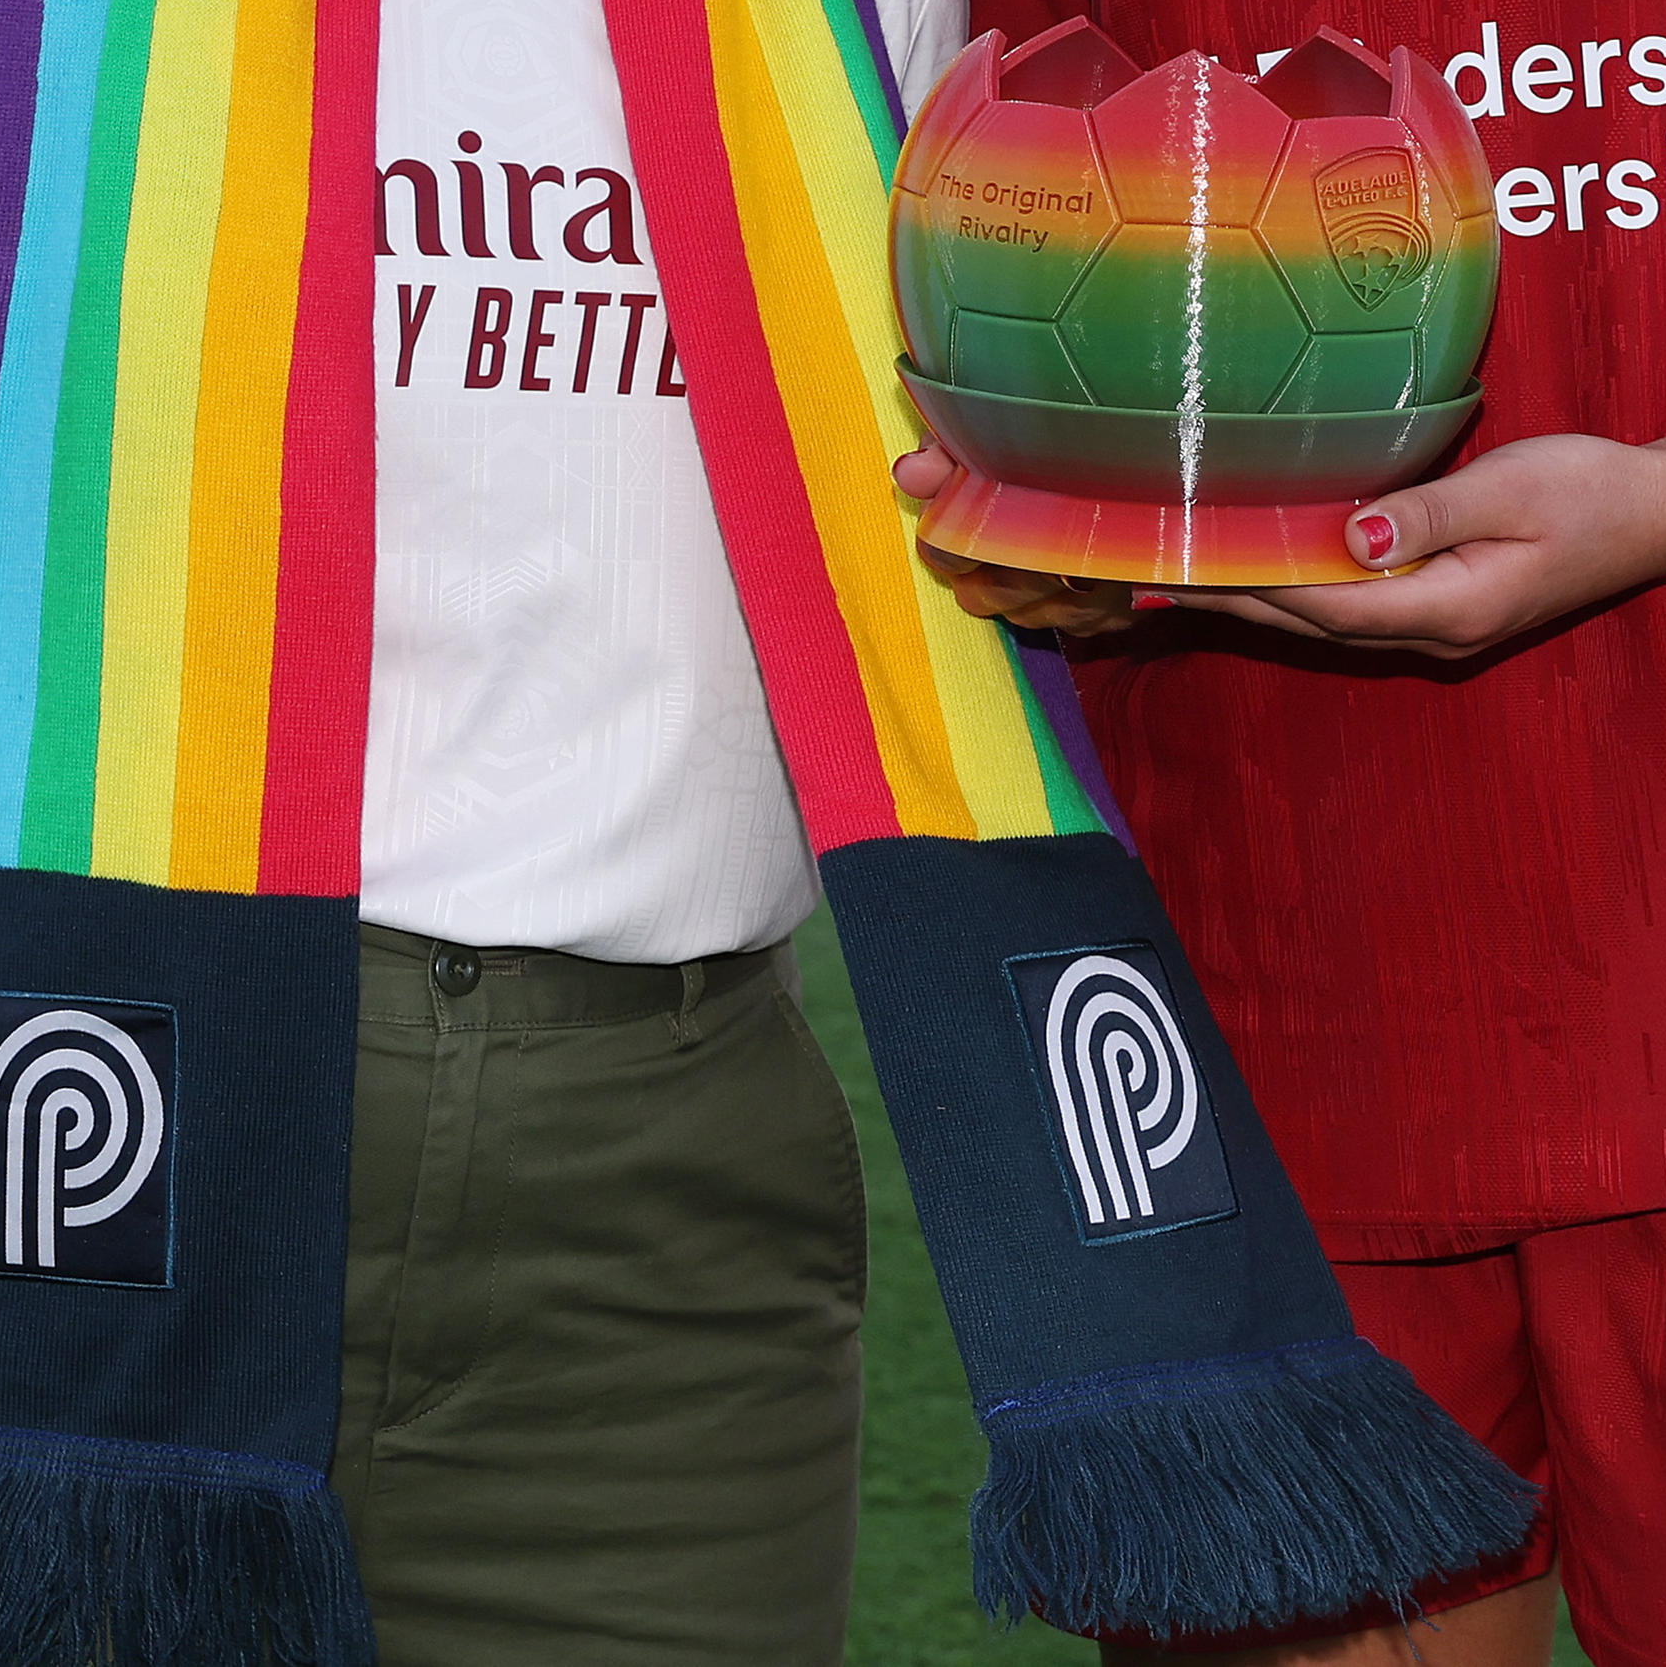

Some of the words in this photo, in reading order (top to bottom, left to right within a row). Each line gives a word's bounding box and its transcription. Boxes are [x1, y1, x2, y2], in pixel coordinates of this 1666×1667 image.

[940, 174, 975, 201] The
[982, 182, 1093, 215] Original
[1323, 171, 1409, 195] ADELAIDE
[959, 216, 1049, 253] Rivalry
